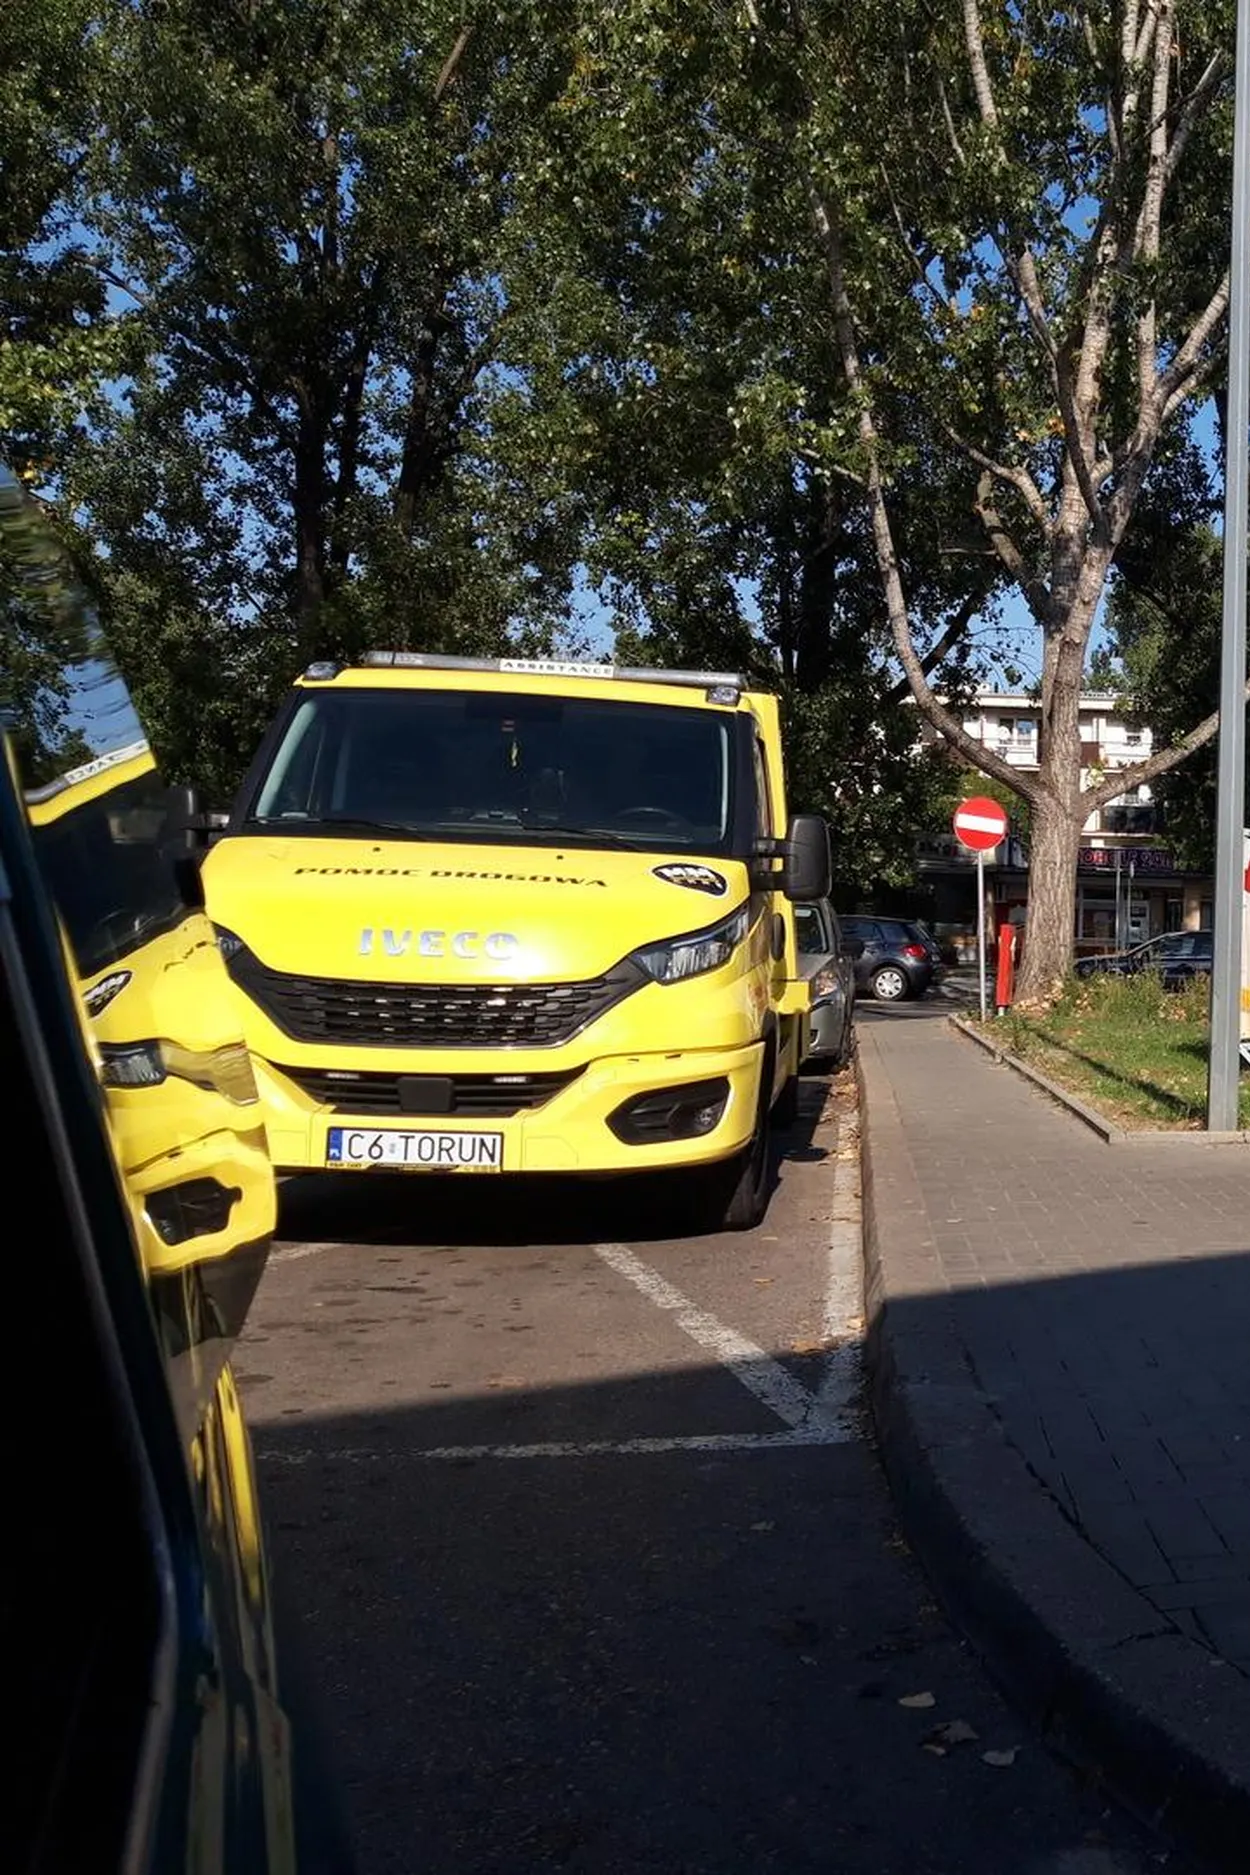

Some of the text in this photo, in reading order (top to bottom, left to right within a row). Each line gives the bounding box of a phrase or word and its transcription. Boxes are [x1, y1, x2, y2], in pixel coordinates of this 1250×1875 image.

[504, 661, 612, 675] ASSISTANCE
[294, 868, 608, 887] POMOC DROGOWA
[358, 928, 519, 960] IVECO
[347, 1133, 497, 1163] C6 TORUN
